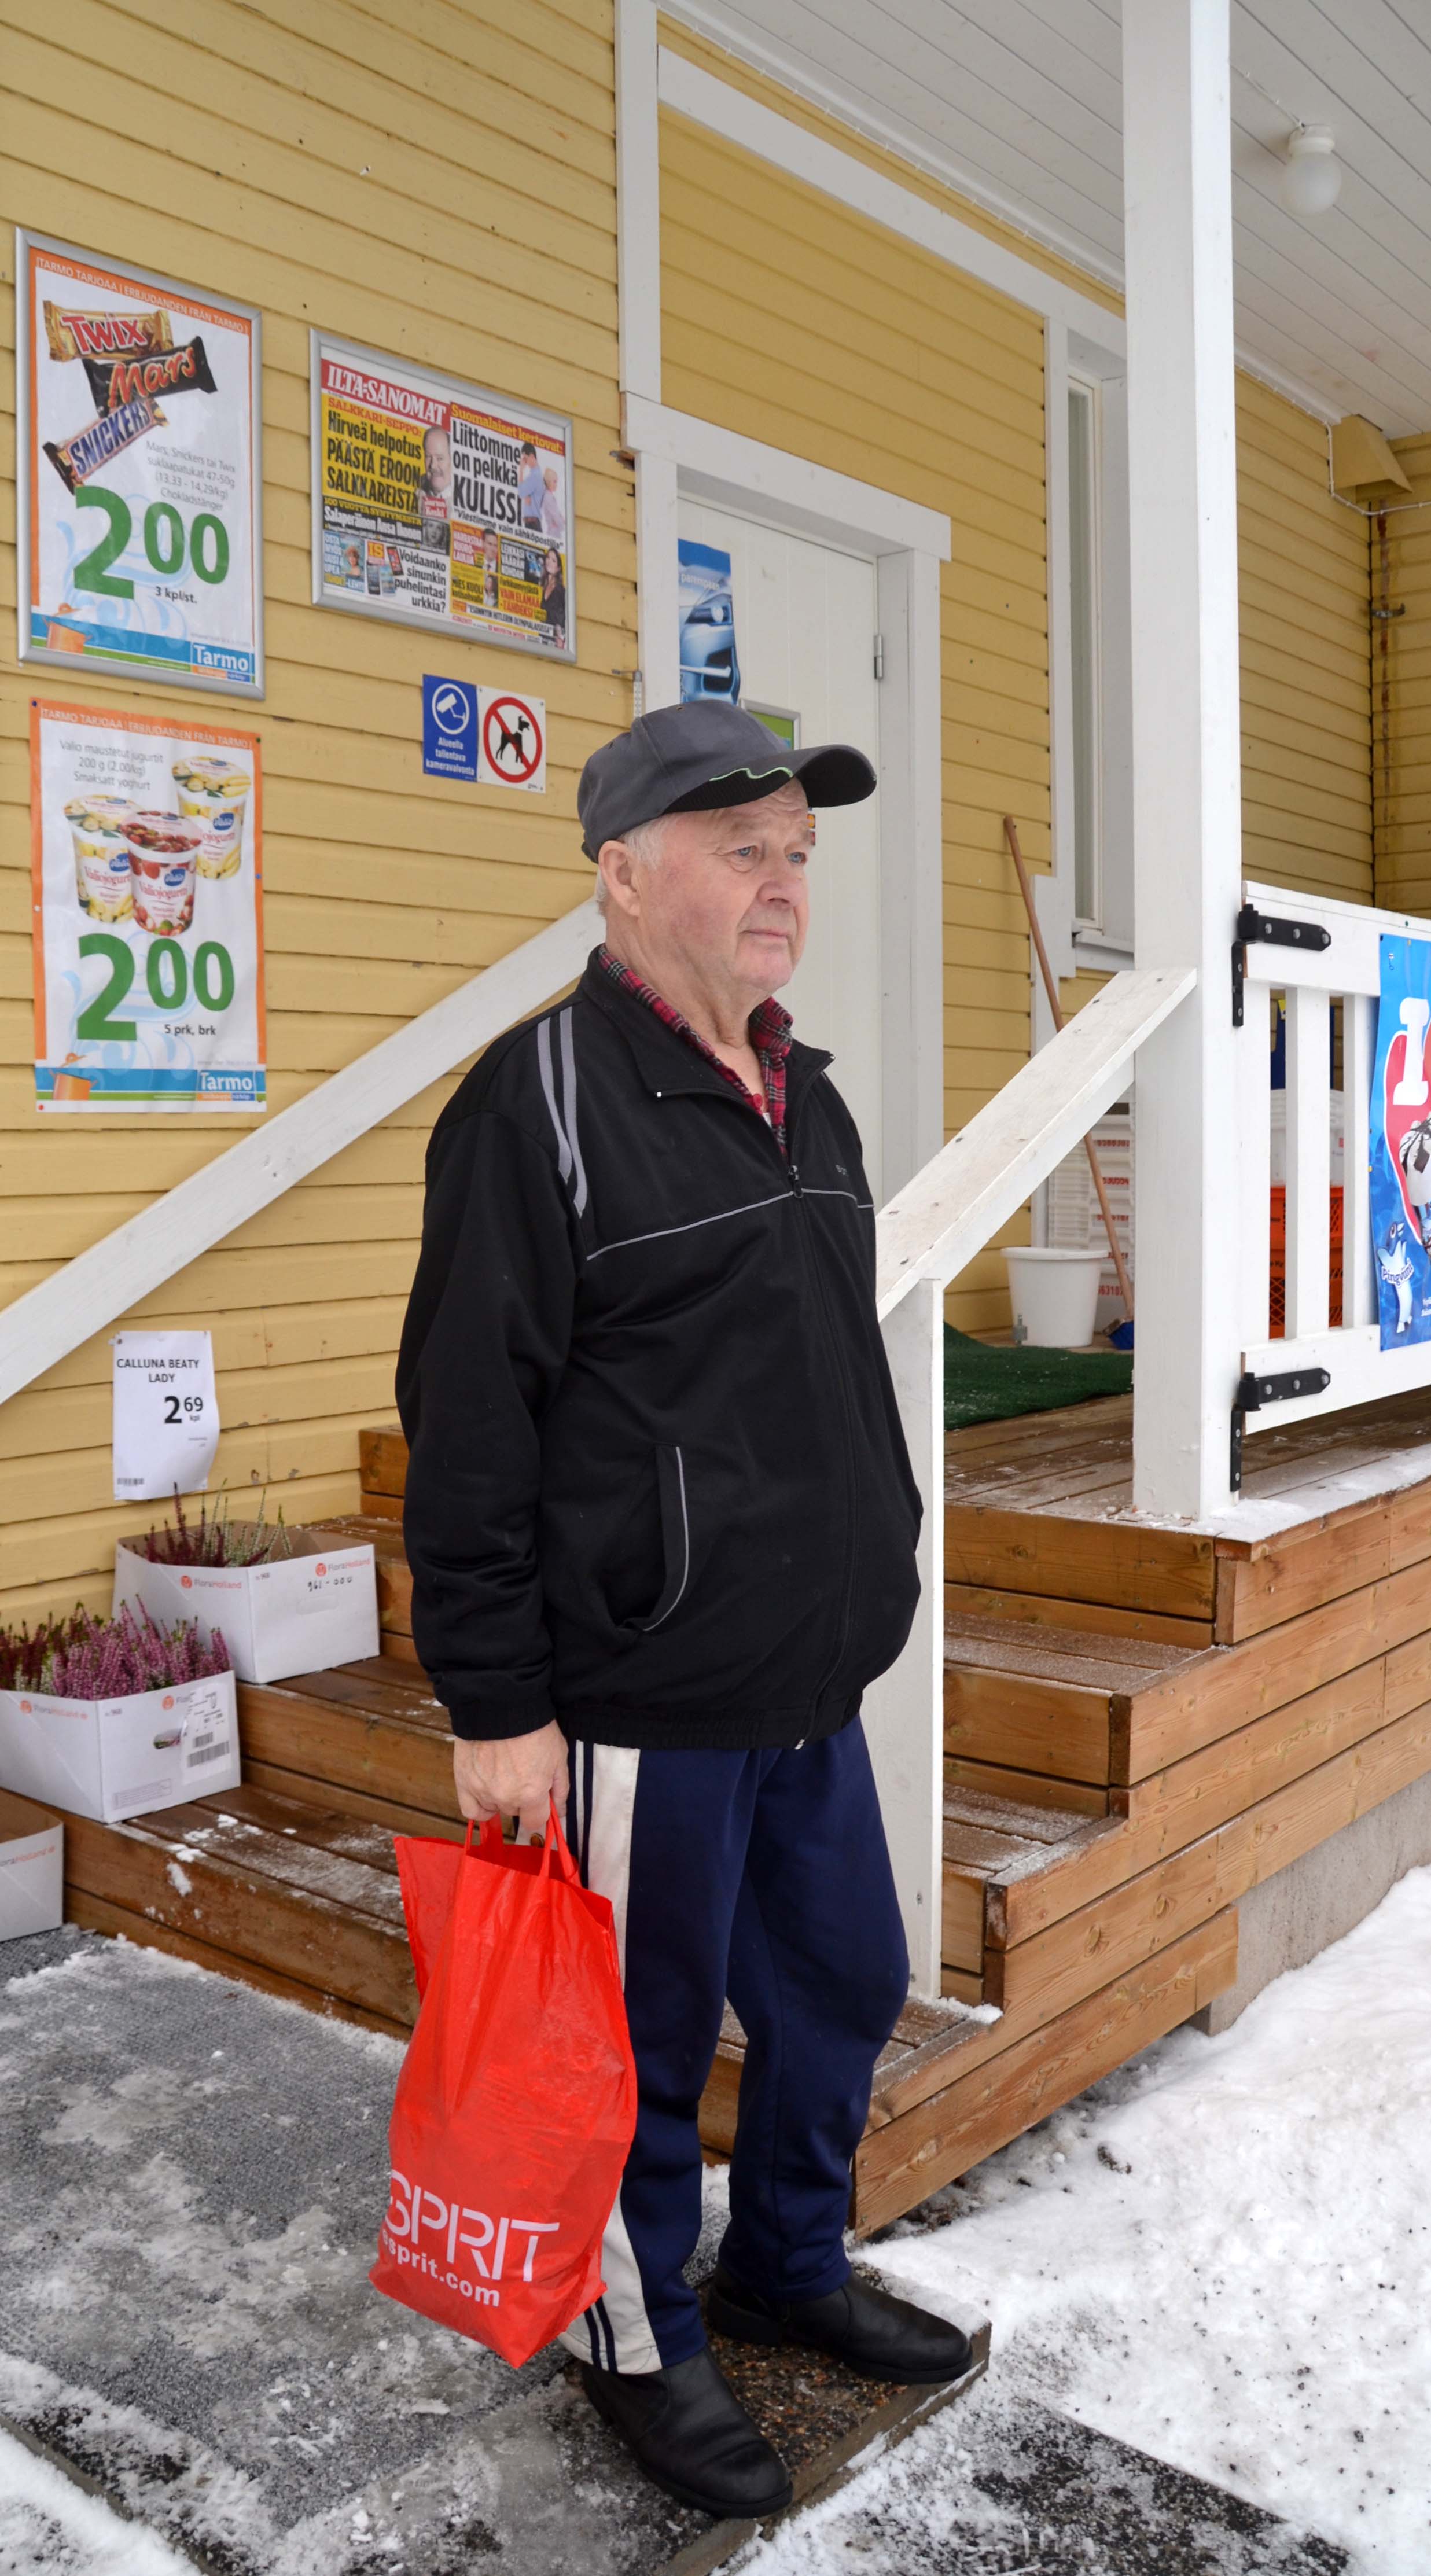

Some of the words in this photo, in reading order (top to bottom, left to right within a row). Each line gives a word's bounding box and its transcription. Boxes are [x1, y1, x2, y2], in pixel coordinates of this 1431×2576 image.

[109, 347, 197, 408] Mars
[451, 404, 517, 437] Suomalaiset
[69, 401, 152, 476] SNICKERS
[328, 410, 367, 444] Hirveä
[370, 425, 421, 459] helpotus
[453, 421, 520, 465] Liittomme
[328, 437, 375, 474] PÄÄSTÄ
[380, 454, 421, 488] EROON
[453, 450, 470, 472] on
[474, 456, 518, 487] pelkkä
[453, 474, 521, 527] KULISSI
[400, 547, 446, 572] Voidaanko
[395, 578, 446, 599] puhelintasi
[407, 568, 446, 586] sinunkin
[155, 587, 161, 597] 3
[411, 597, 446, 613] urkkia?
[193, 645, 249, 672] Tarmo
[79, 756, 96, 768] 200
[425, 759, 474, 775] kameravalvonta
[198, 1025, 216, 1036] brk
[200, 1073, 253, 1091] Tarmo
[117, 1358, 165, 1369] CALLUNA
[169, 1359, 200, 1369] BEATY
[149, 1373, 175, 1383] LADY
[385, 2169, 560, 2282] SPRIT
